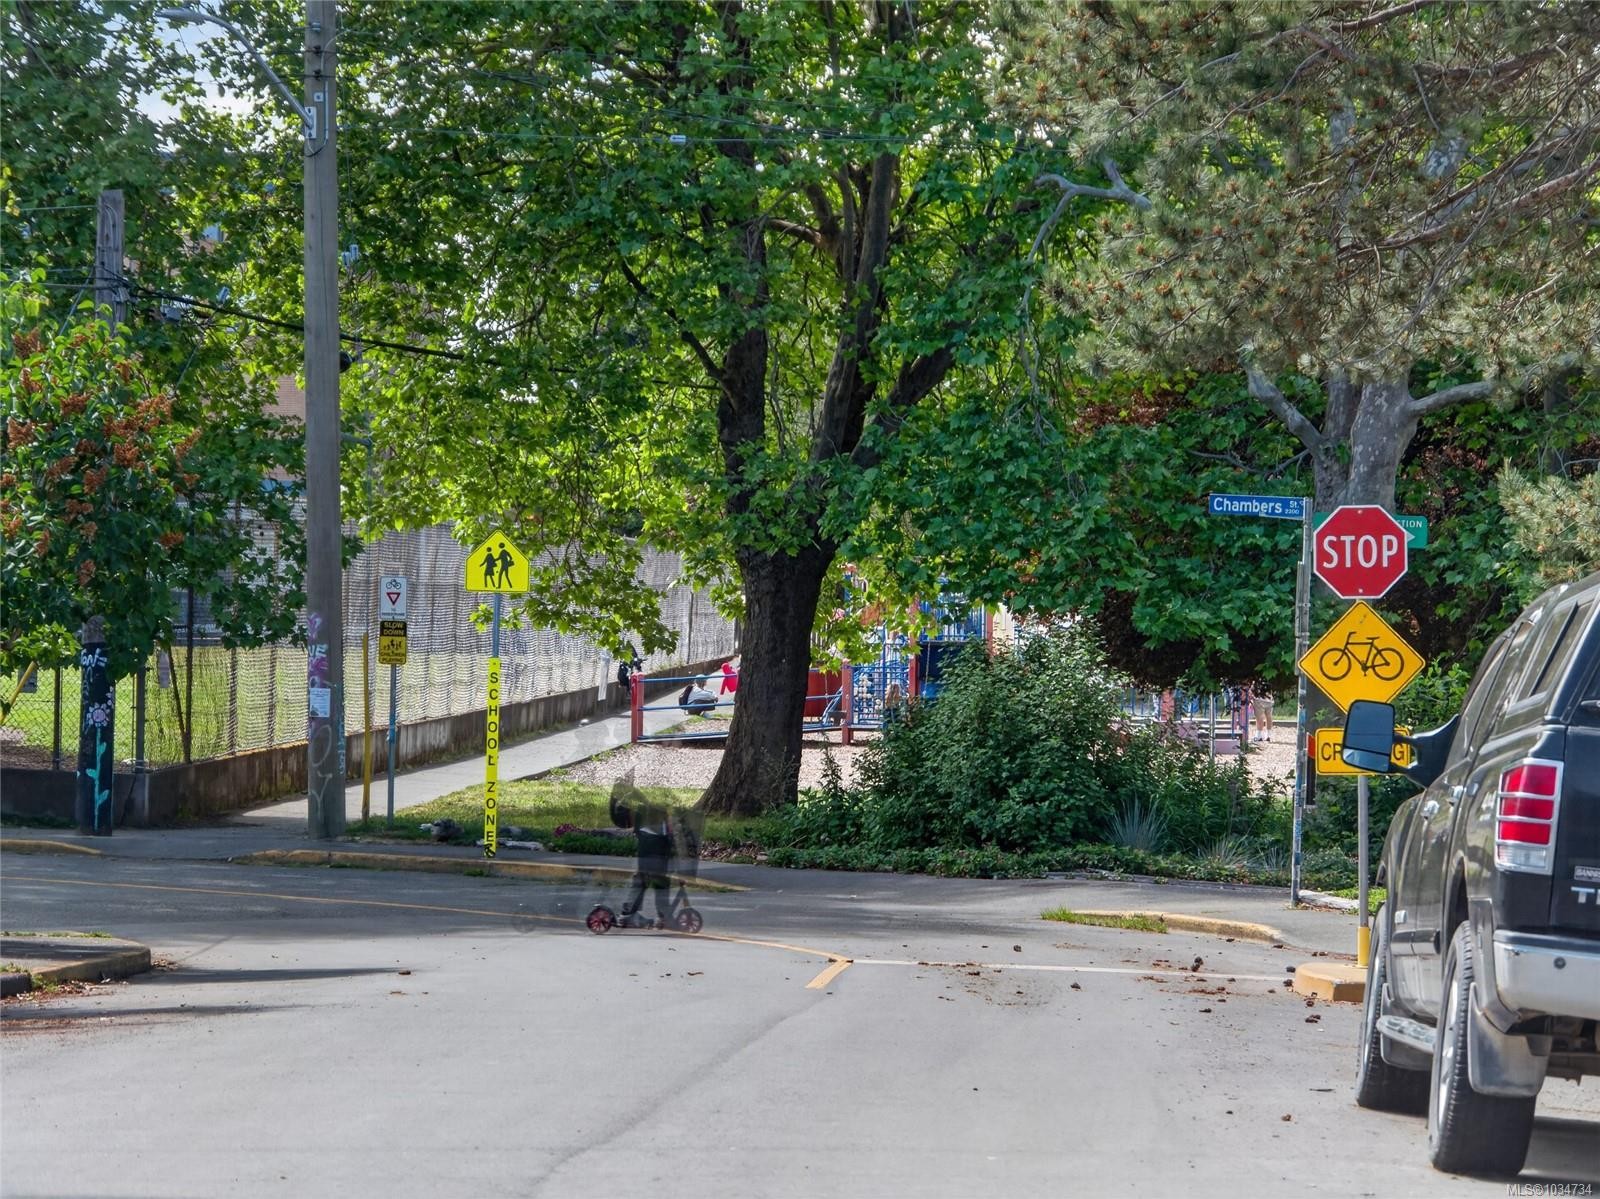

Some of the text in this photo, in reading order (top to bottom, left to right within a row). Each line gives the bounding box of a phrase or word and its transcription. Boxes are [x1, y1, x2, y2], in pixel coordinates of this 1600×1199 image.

[1213, 497, 1282, 514] Chambers
[1322, 534, 1399, 569] STOP
[384, 621, 404, 629] SLOW
[484, 672, 499, 843] SCHOOL ZONE
